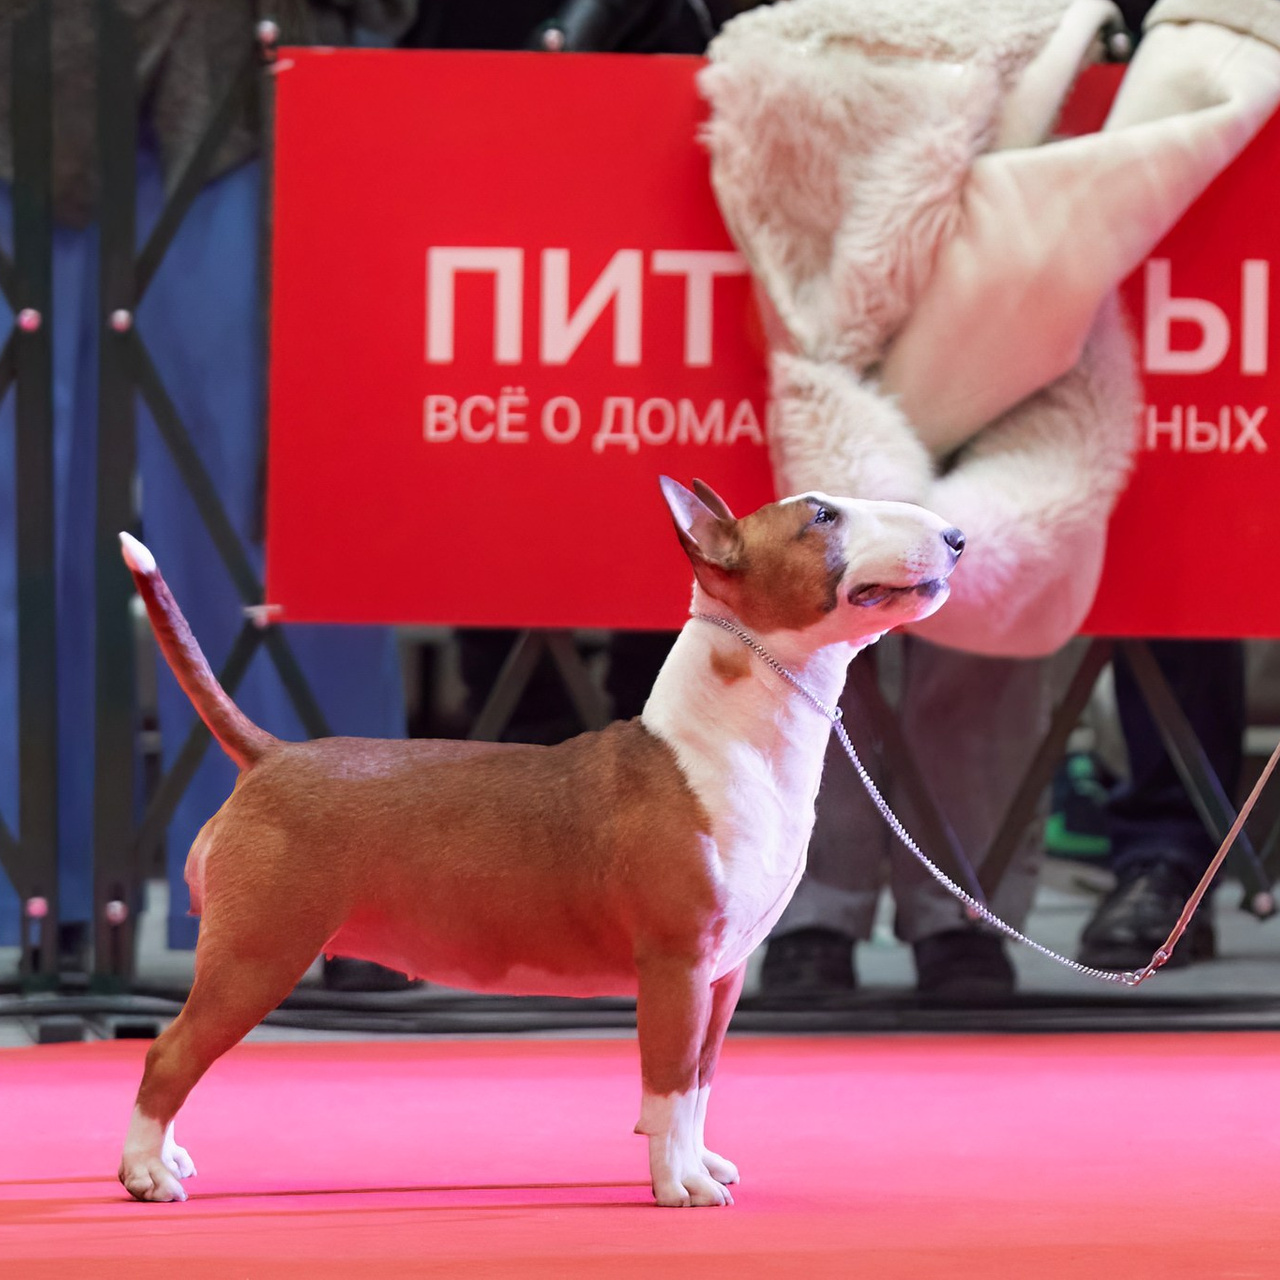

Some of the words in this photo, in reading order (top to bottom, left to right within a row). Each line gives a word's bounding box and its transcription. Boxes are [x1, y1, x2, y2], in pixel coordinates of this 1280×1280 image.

[423, 385, 529, 444] ВСЁ
[541, 396, 581, 444] О
[592, 396, 774, 454] ДОМА
